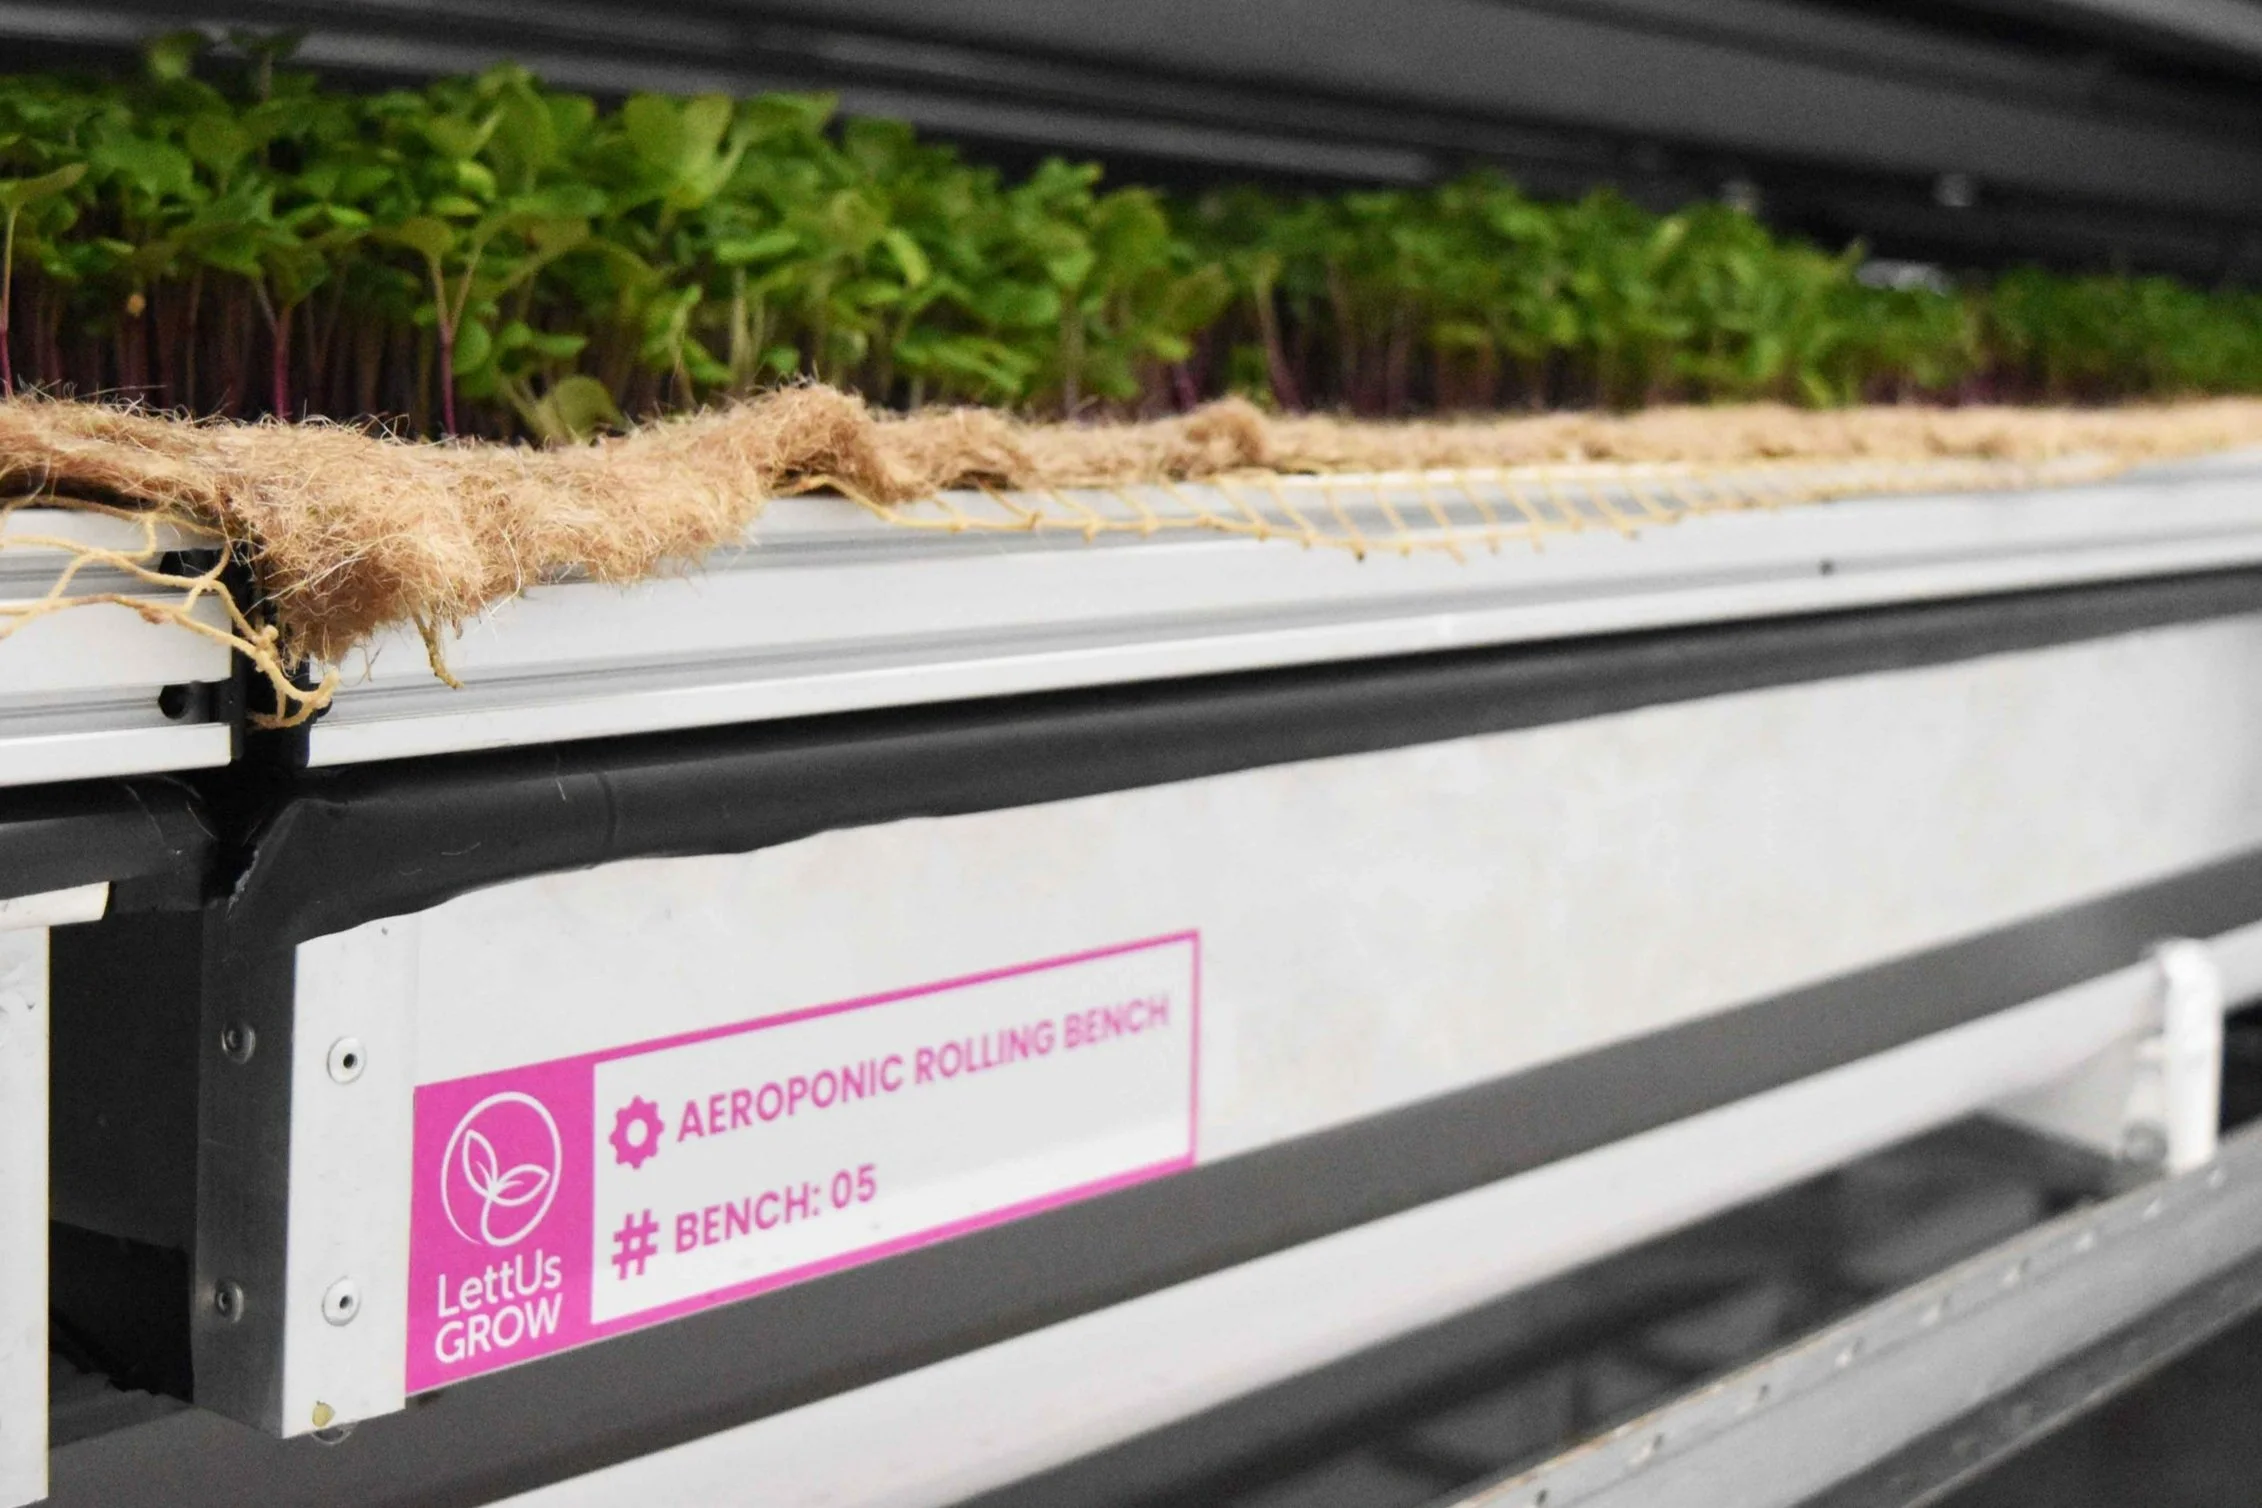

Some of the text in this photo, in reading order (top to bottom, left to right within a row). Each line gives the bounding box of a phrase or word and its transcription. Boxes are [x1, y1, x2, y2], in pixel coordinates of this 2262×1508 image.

[676, 994, 1170, 1143] AEROPONIC ROLLING BENCH
[674, 1183, 821, 1254] BENCH:
[830, 1163, 878, 1211] 05
[438, 1249, 563, 1318] LettUs
[434, 1293, 563, 1364] GROW
